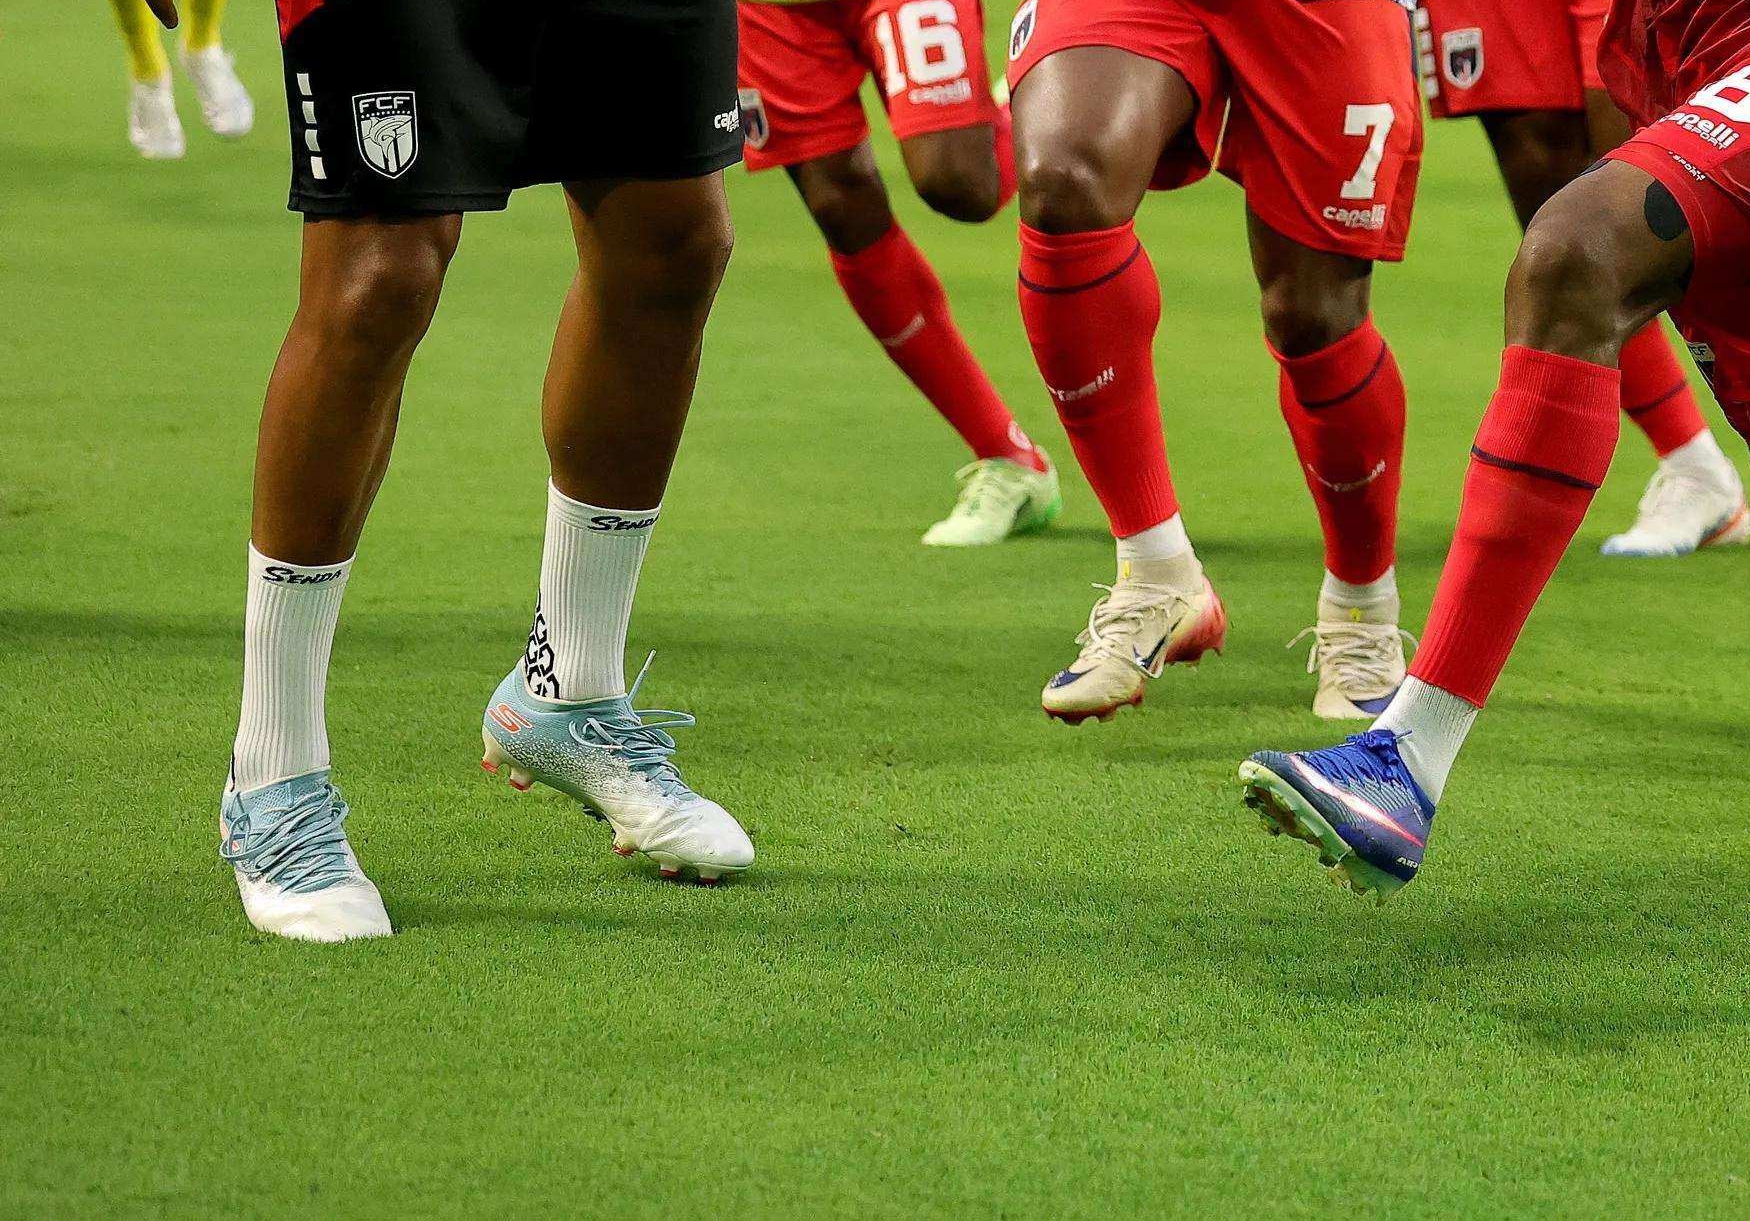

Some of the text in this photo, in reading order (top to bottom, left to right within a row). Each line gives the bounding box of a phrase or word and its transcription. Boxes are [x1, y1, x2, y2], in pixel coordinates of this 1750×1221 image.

[359, 96, 410, 114] FCF
[1659, 112, 1740, 149] apelli
[1339, 102, 1396, 200] 7
